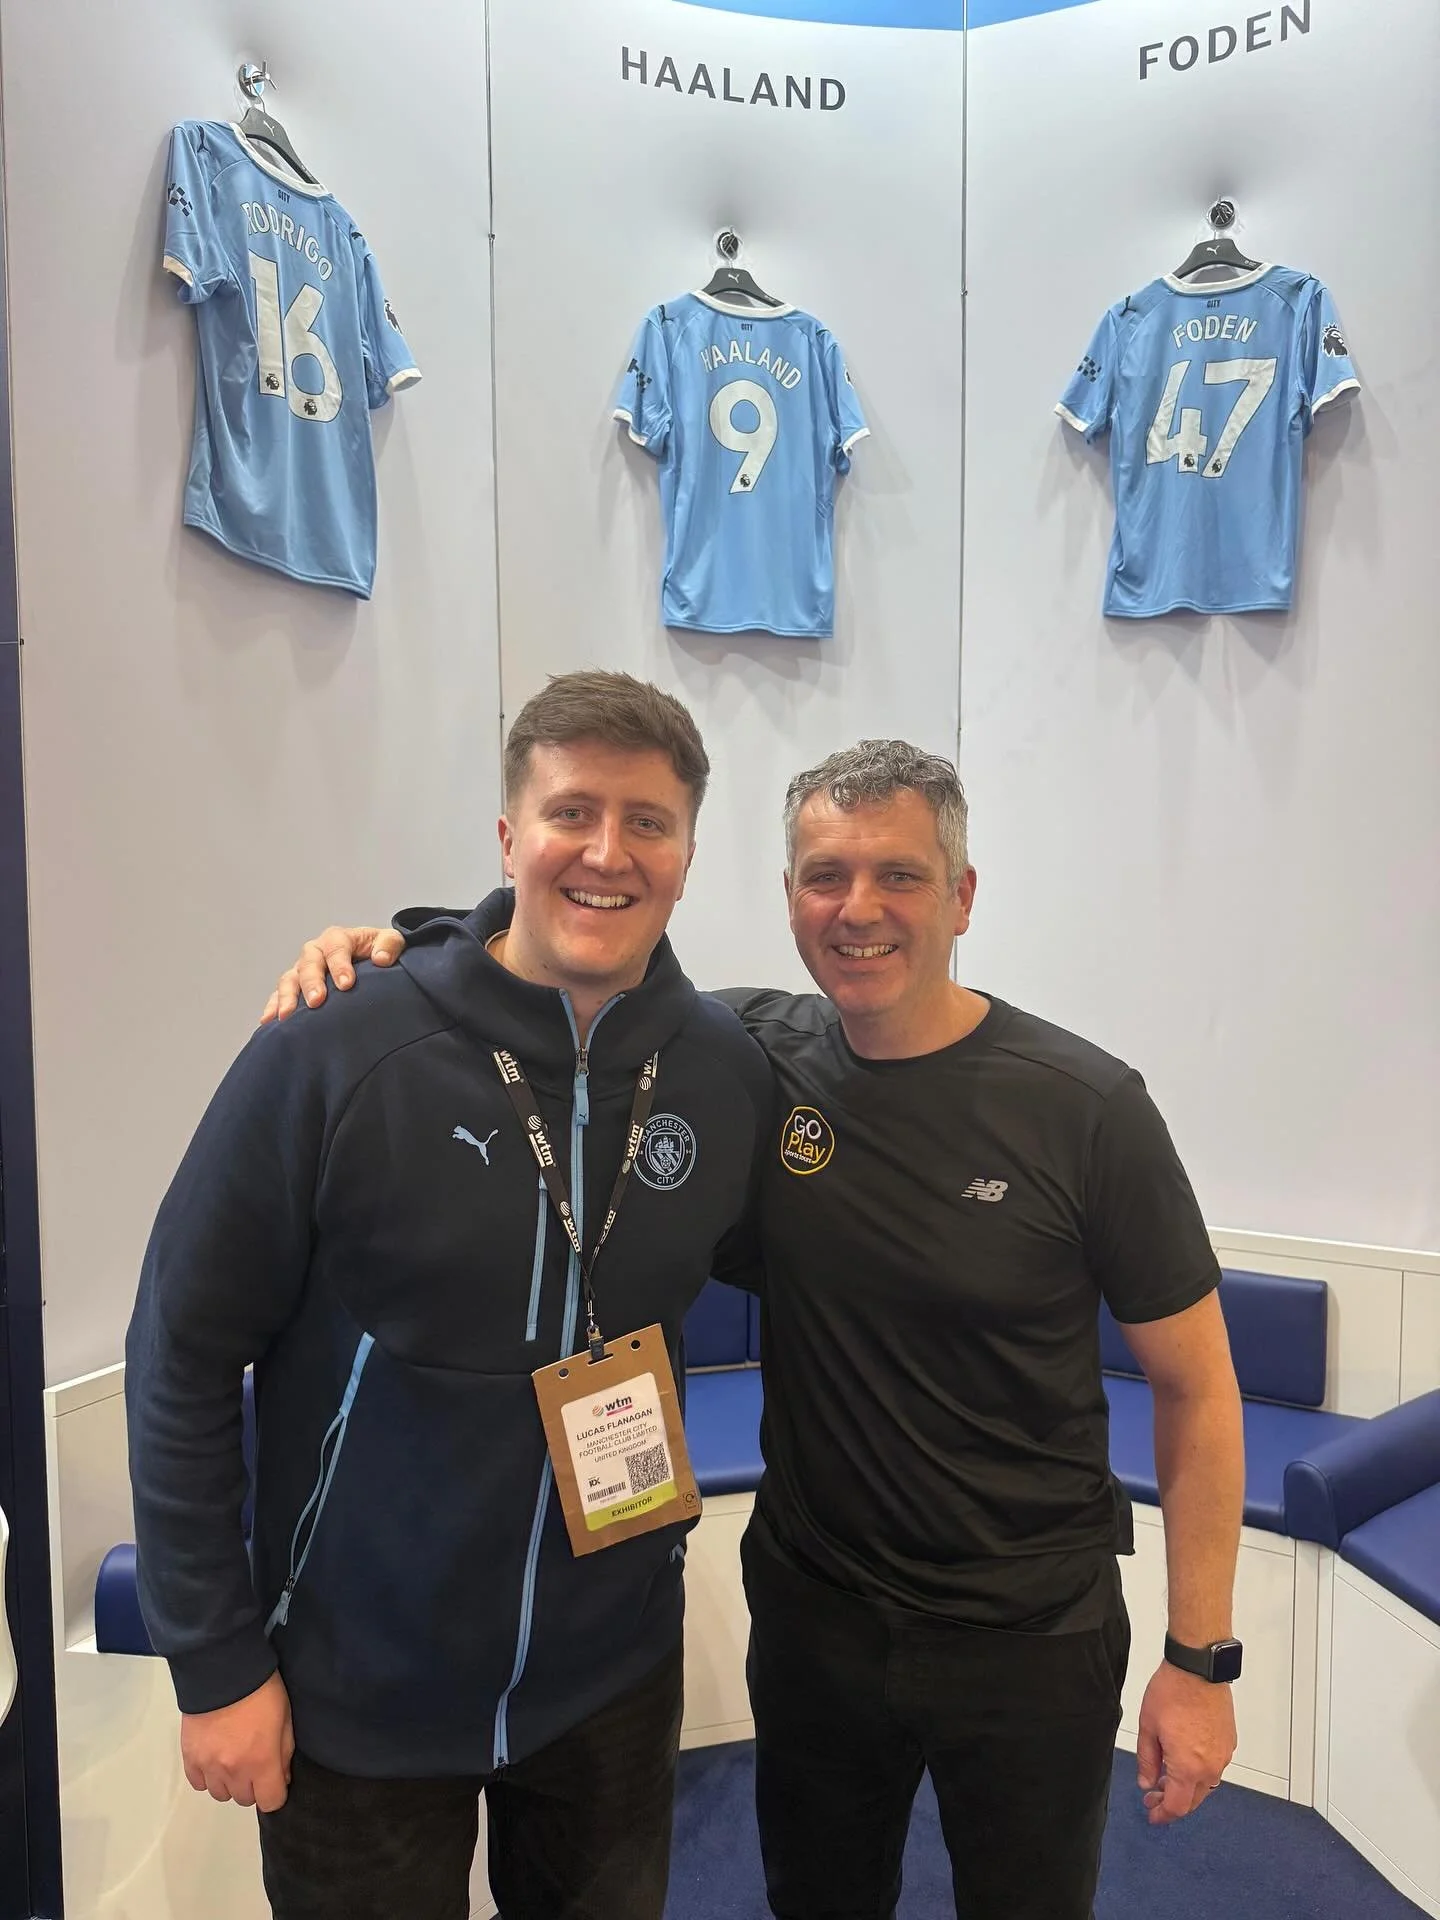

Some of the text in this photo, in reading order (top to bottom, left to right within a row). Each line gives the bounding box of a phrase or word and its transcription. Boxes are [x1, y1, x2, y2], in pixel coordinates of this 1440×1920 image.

[1139, 0, 1311, 81] FODEN
[621, 46, 846, 111] HAALAND
[240, 201, 334, 282] RODRIGO
[248, 249, 343, 423] 16
[1172, 314, 1258, 350] FODEN
[700, 340, 802, 390] HAALAND
[1146, 357, 1278, 478] 47
[708, 379, 778, 494] 9
[500, 1049, 521, 1083] wtm
[627, 1124, 640, 1158] wtm
[641, 1119, 690, 1143] MANCHESTER
[794, 1114, 822, 1140] GO
[535, 1130, 554, 1166] wtm
[656, 1175, 675, 1185] CITY
[605, 1396, 632, 1411] wtm
[576, 1408, 653, 1441] LUCAS FLANAGAN
[586, 1422, 648, 1449] MANCHESTER CITY
[579, 1425, 658, 1459] FOOTBALL CLUB LIMITED
[594, 1439, 647, 1463] UNITED KINGDOM
[612, 1496, 653, 1517] EXHIBITOR
